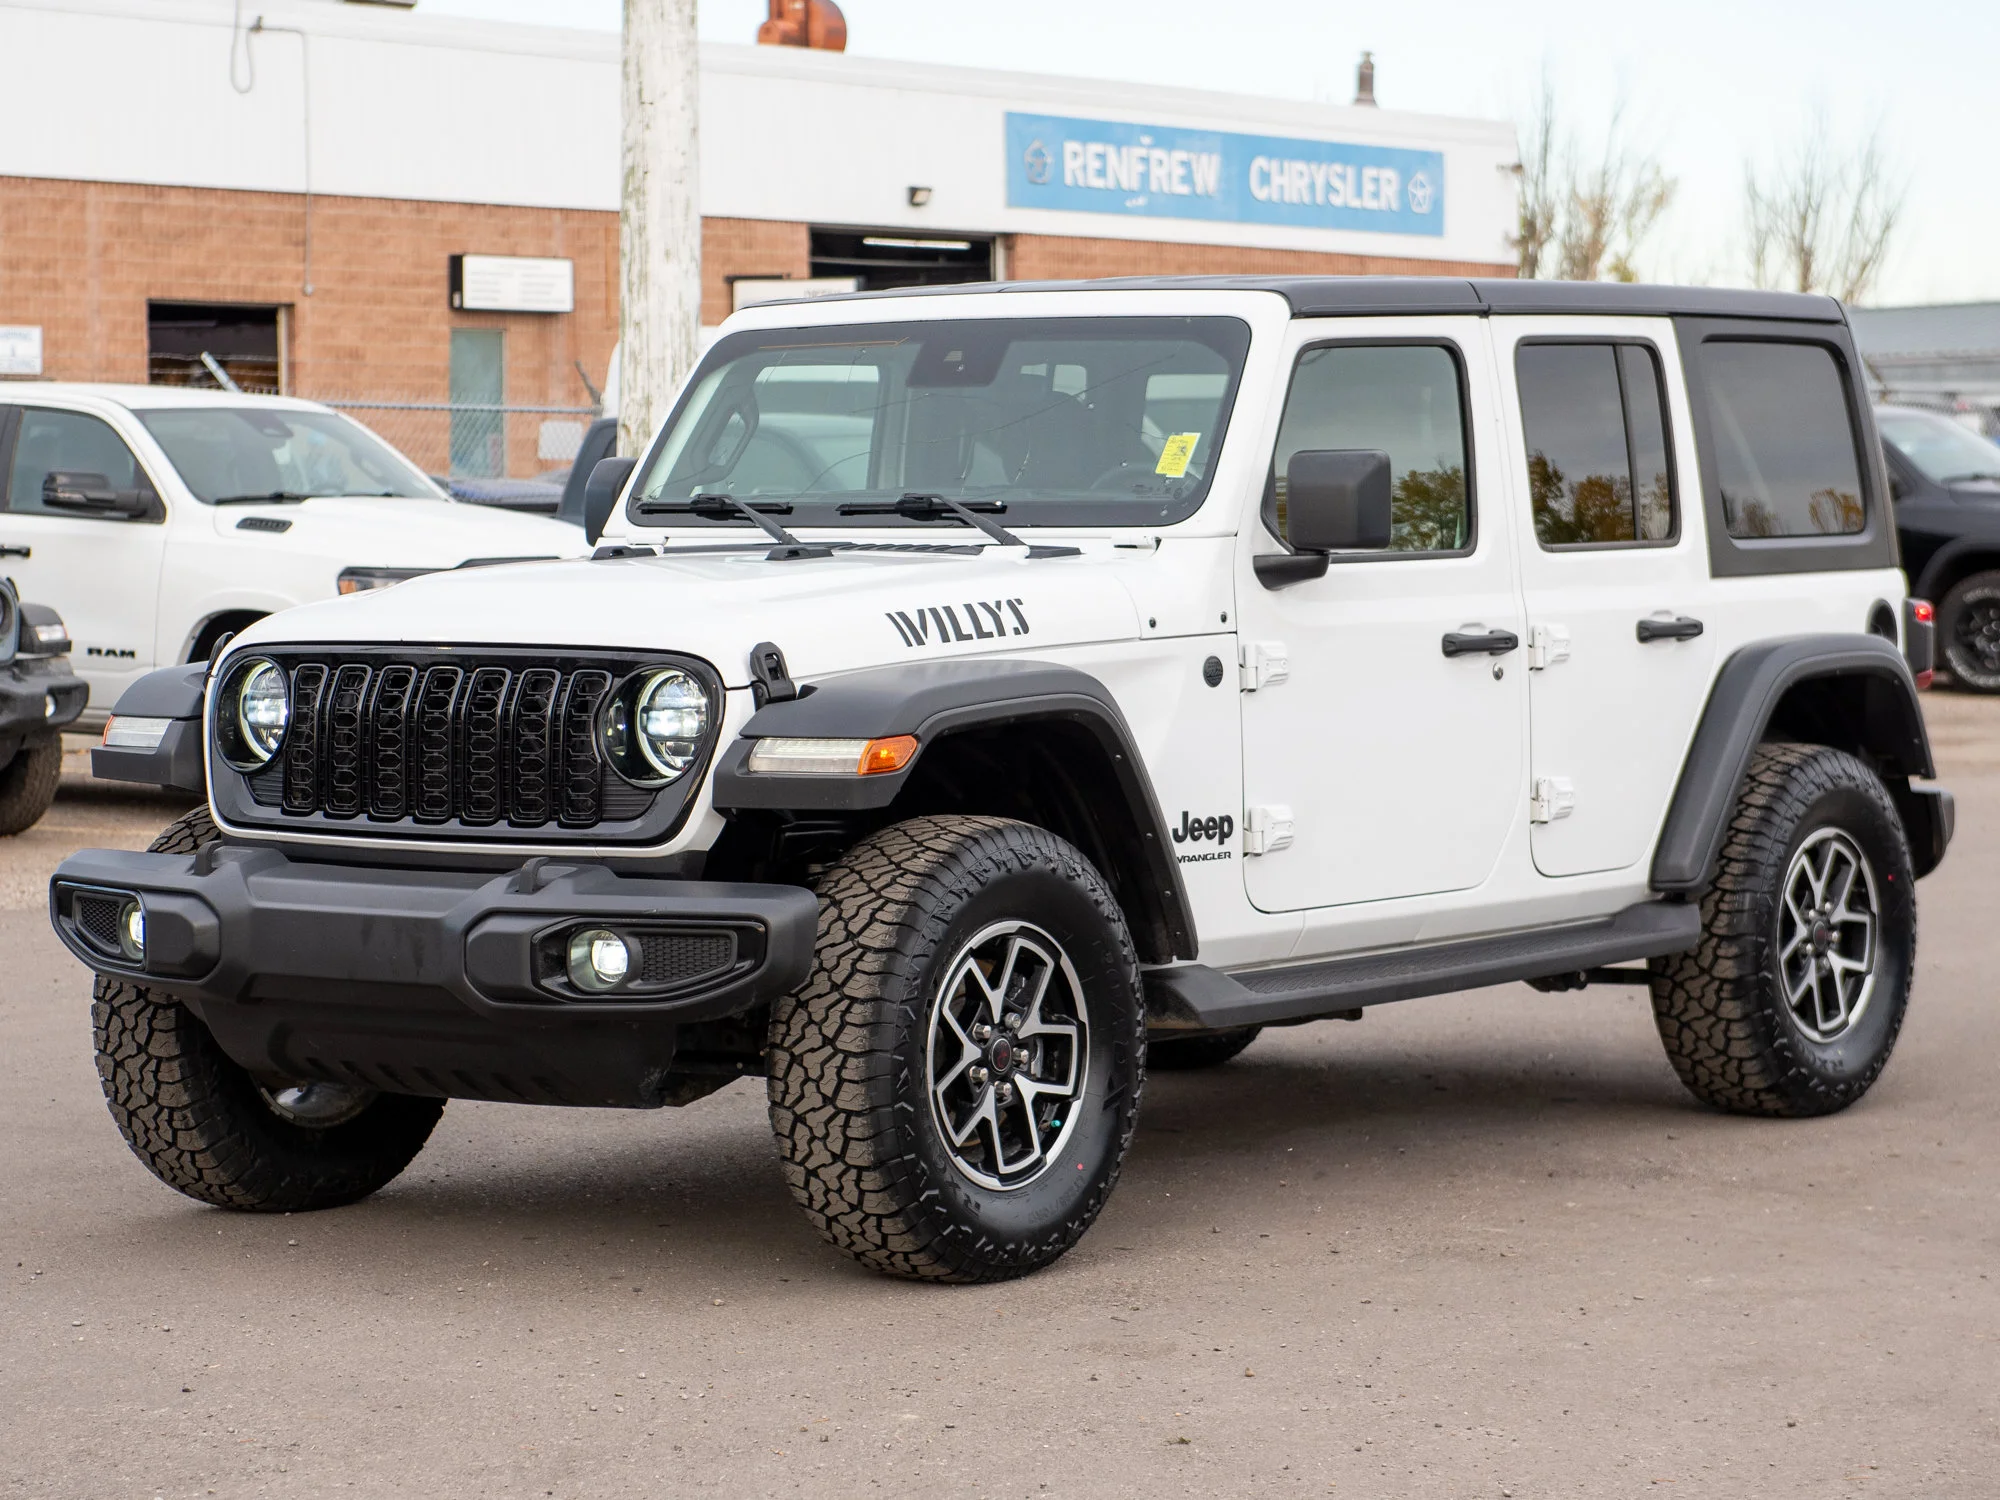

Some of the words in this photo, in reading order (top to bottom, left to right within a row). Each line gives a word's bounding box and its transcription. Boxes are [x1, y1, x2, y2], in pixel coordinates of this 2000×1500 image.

[1063, 140, 1220, 197] RENFREW
[1249, 155, 1400, 212] CHRYSLER
[885, 598, 1030, 647] WILLYS
[87, 647, 136, 659] RAM
[1172, 811, 1234, 846] Jeep
